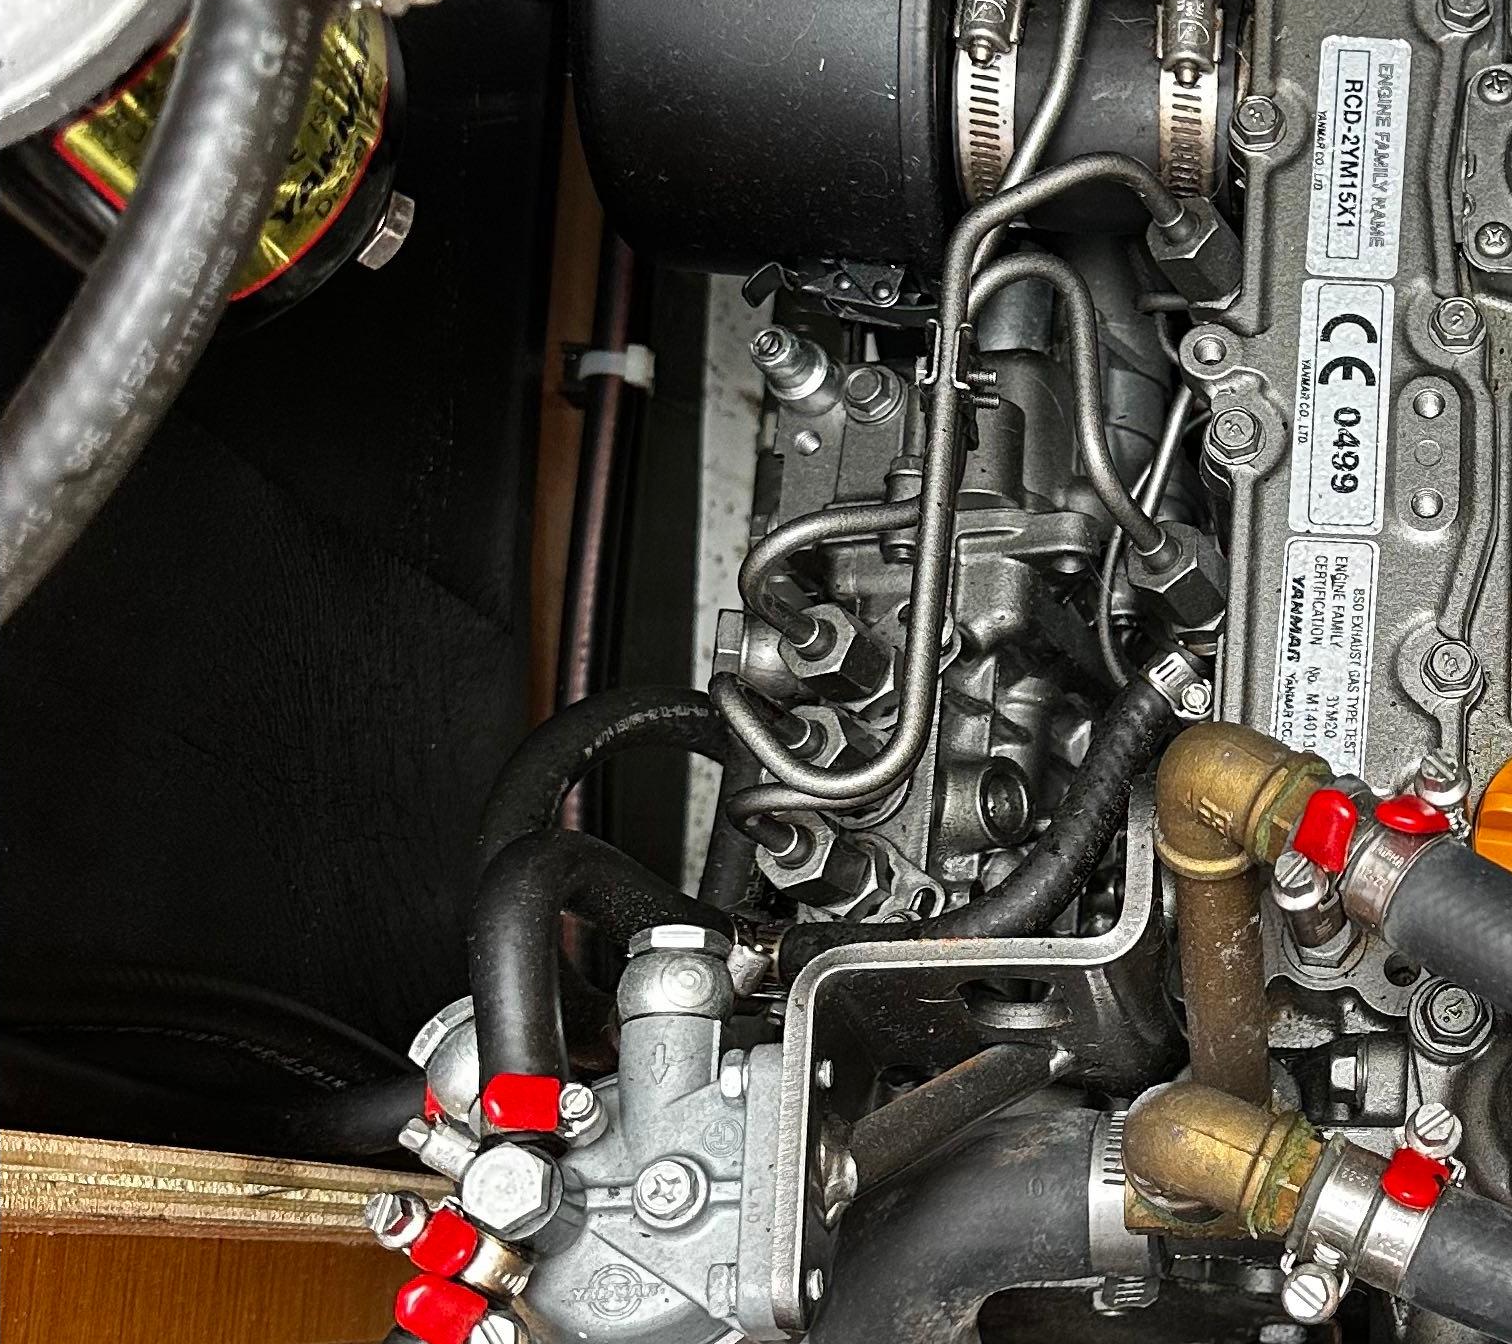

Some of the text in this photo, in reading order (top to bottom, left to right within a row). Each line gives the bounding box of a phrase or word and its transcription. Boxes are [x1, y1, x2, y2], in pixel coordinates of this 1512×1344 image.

[1316, 111, 1327, 148] YANMAR
[1337, 79, 1364, 228] RCD-2YM15X1
[1369, 64, 1394, 247] ENGINE FAMILY NAME
[1299, 359, 1312, 399] YANMAR
[1318, 314, 1377, 494] CE 0499
[1287, 576, 1306, 663] YANMAR
[1309, 556, 1328, 645] CERTIFICATION
[1324, 556, 1348, 738] ENGINE FAMILY 3YM20
[1349, 616, 1363, 666] EXHAUST
[1345, 697, 1359, 723] TYPE
[1348, 670, 1360, 692] GAS
[1344, 728, 1357, 756] TEST
